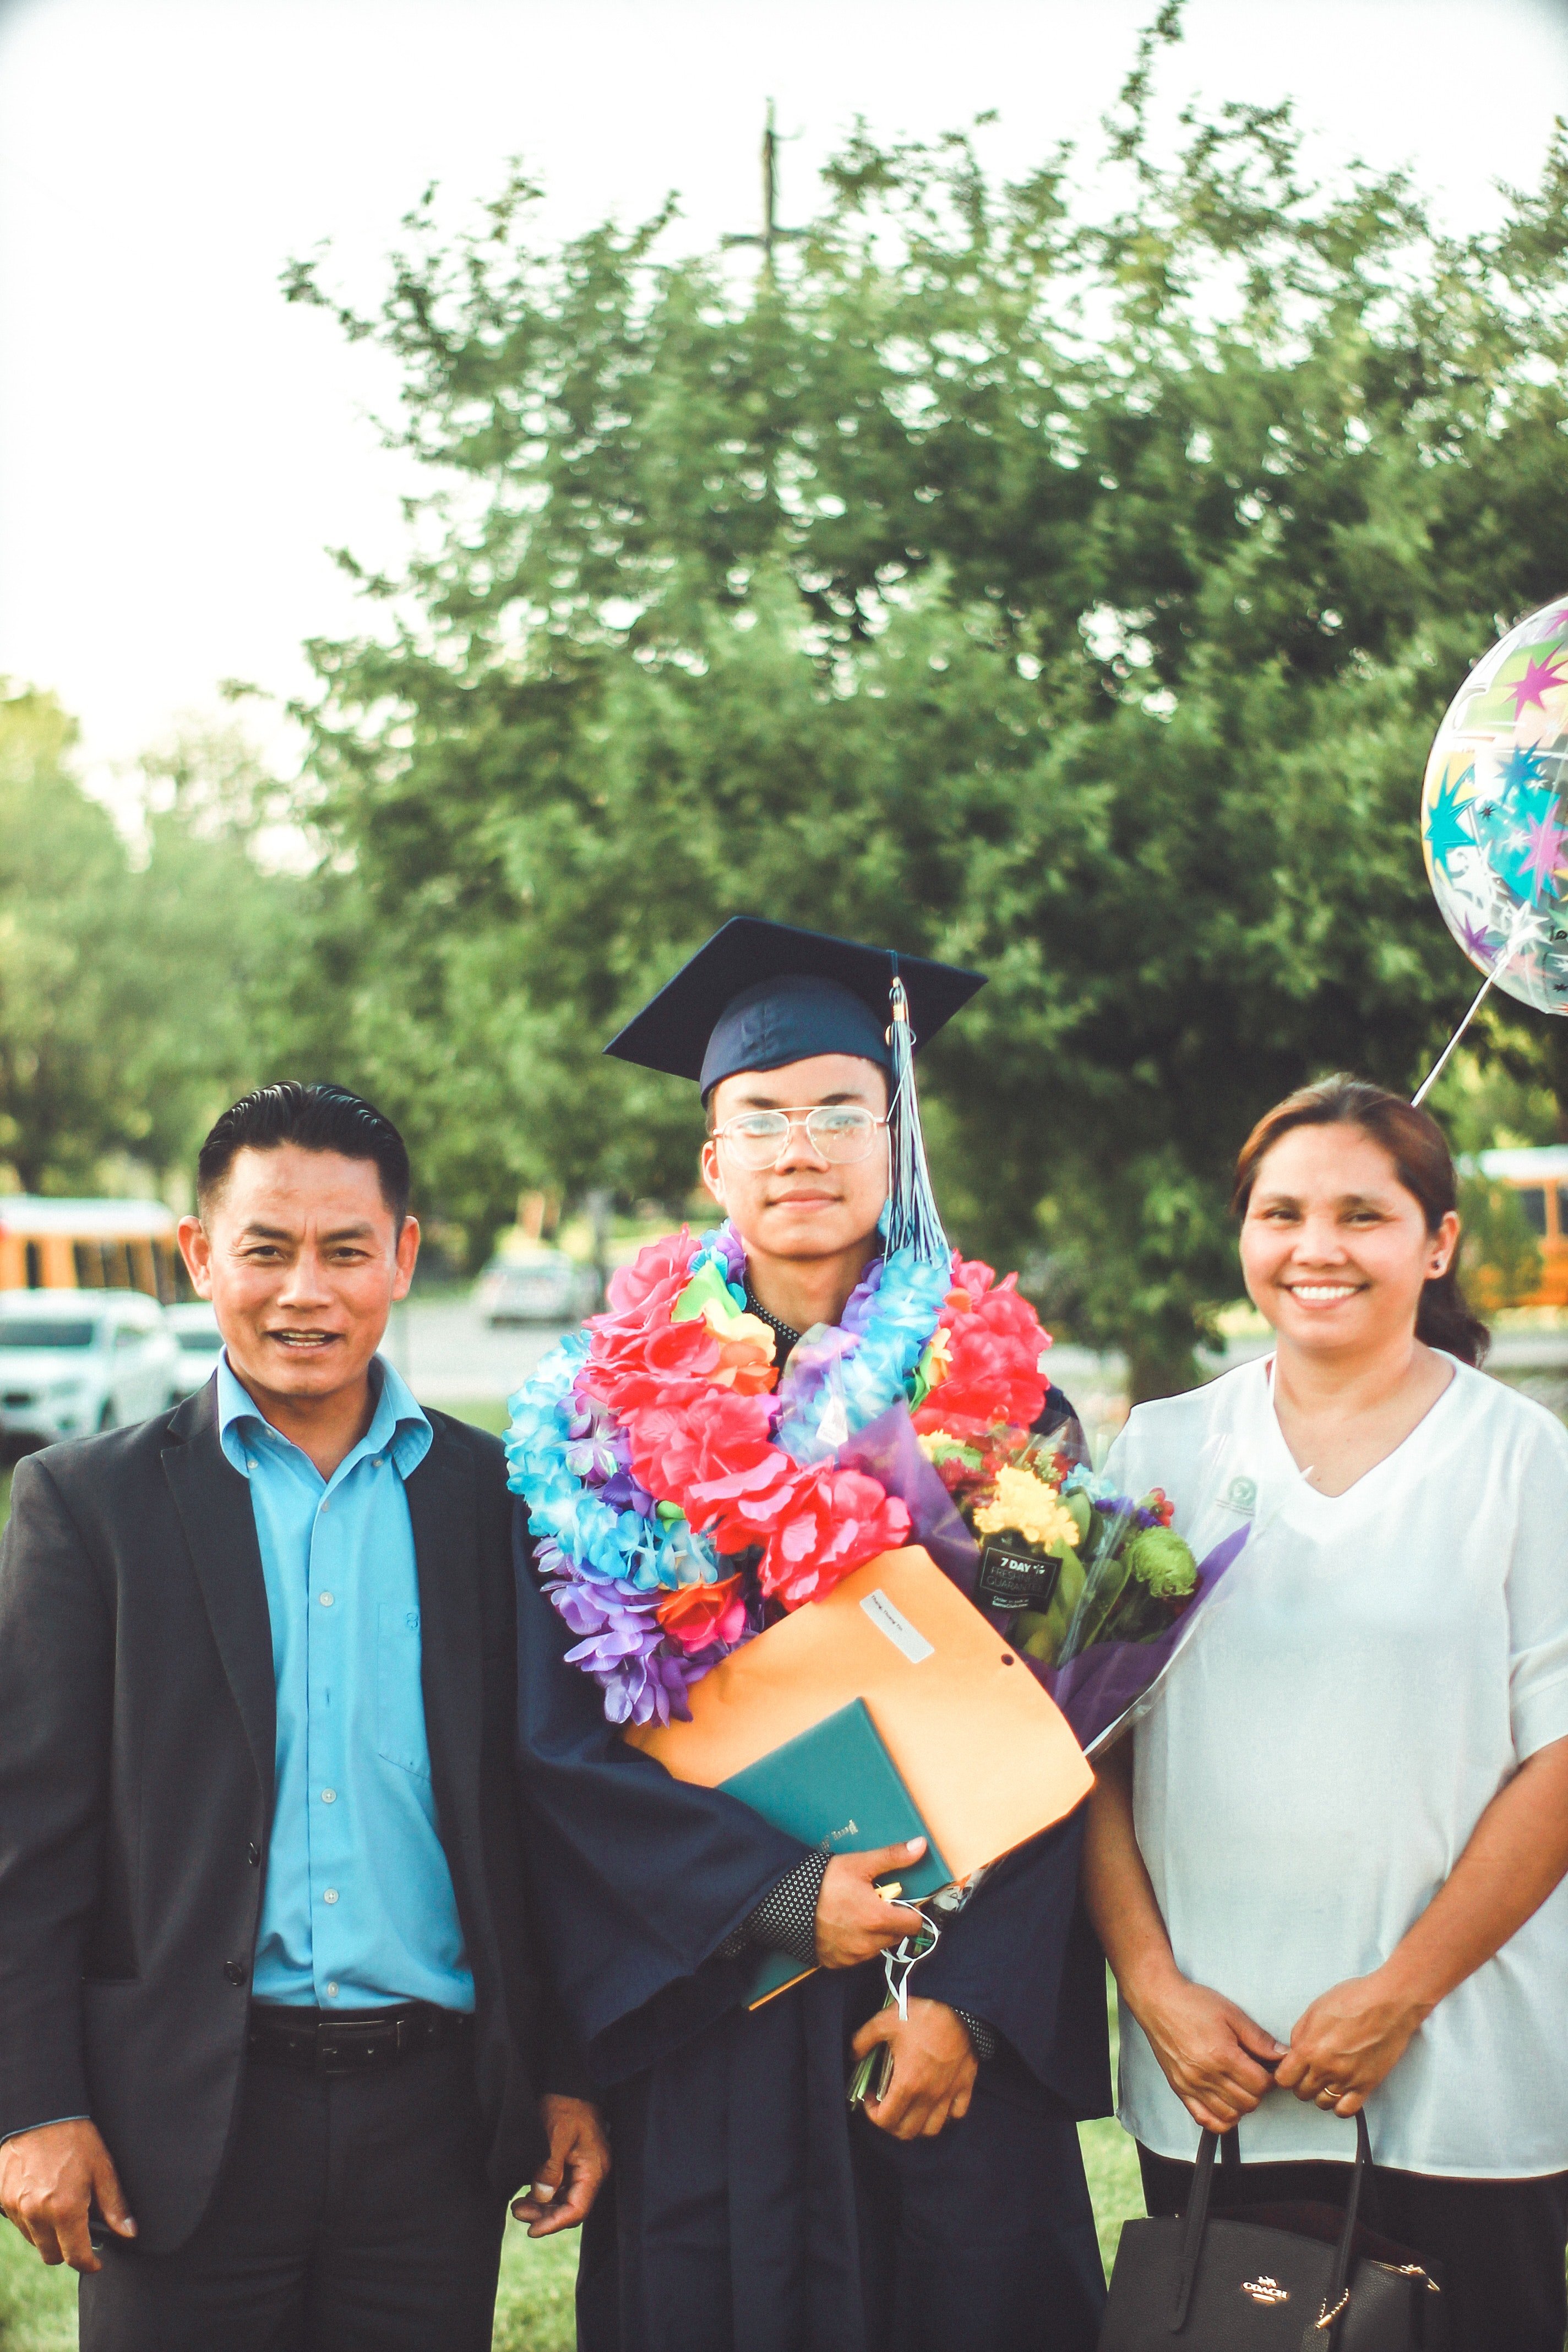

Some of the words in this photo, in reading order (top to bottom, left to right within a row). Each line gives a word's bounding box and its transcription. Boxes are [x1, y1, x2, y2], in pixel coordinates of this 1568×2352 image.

[1000, 1557, 1009, 1566] 7
[1009, 1559, 1031, 1572] DAY
[991, 1566, 1043, 1584] FRESHN
[1243, 2282, 1287, 2299] COACH
